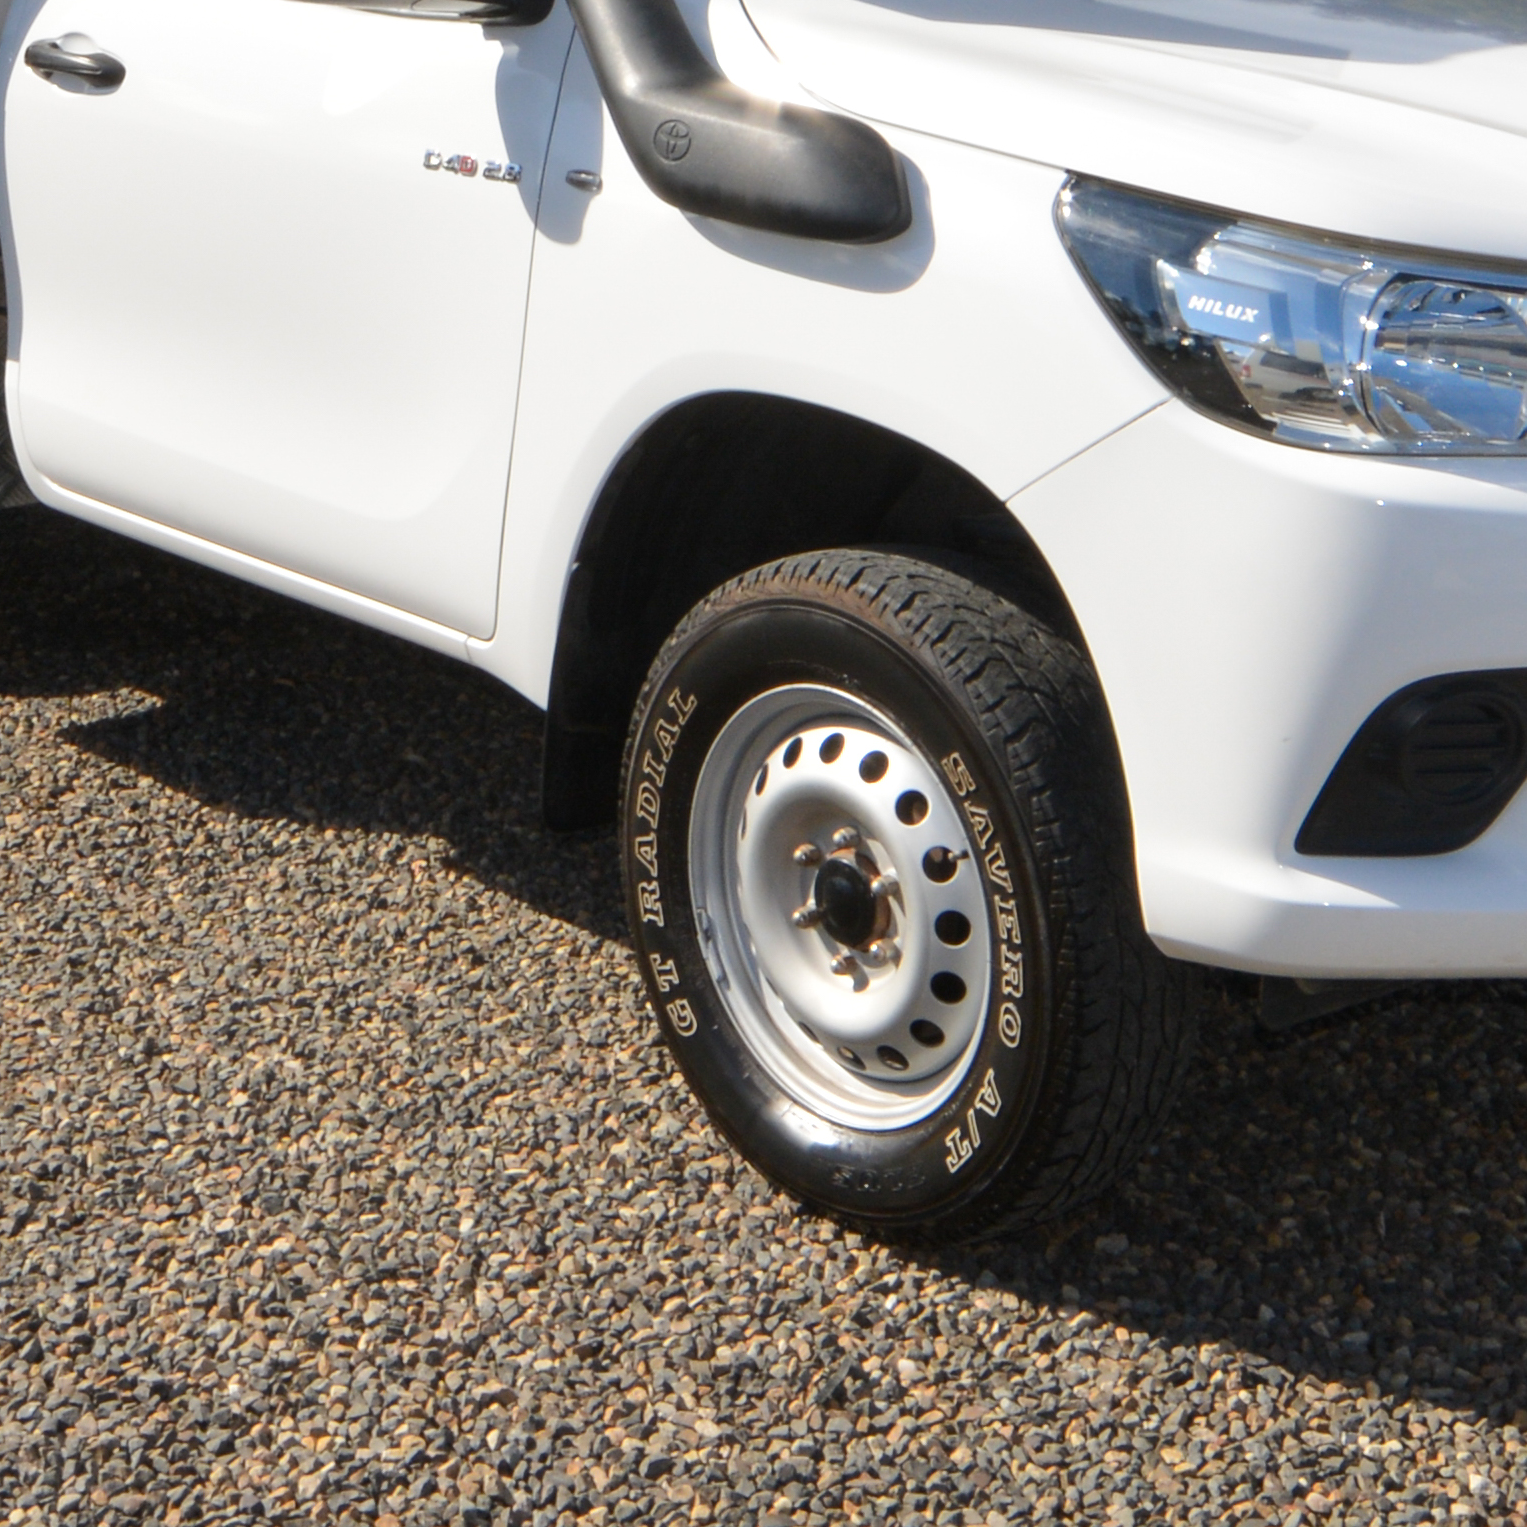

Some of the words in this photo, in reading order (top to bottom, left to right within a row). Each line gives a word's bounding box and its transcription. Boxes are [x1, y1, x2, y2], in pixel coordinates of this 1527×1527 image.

[1187, 294, 1260, 324] HILUX
[634, 686, 698, 928] RADIAL
[942, 752, 1024, 1048] SAVERO
[649, 952, 698, 1038] GT
[944, 1067, 1003, 1174] A/T
